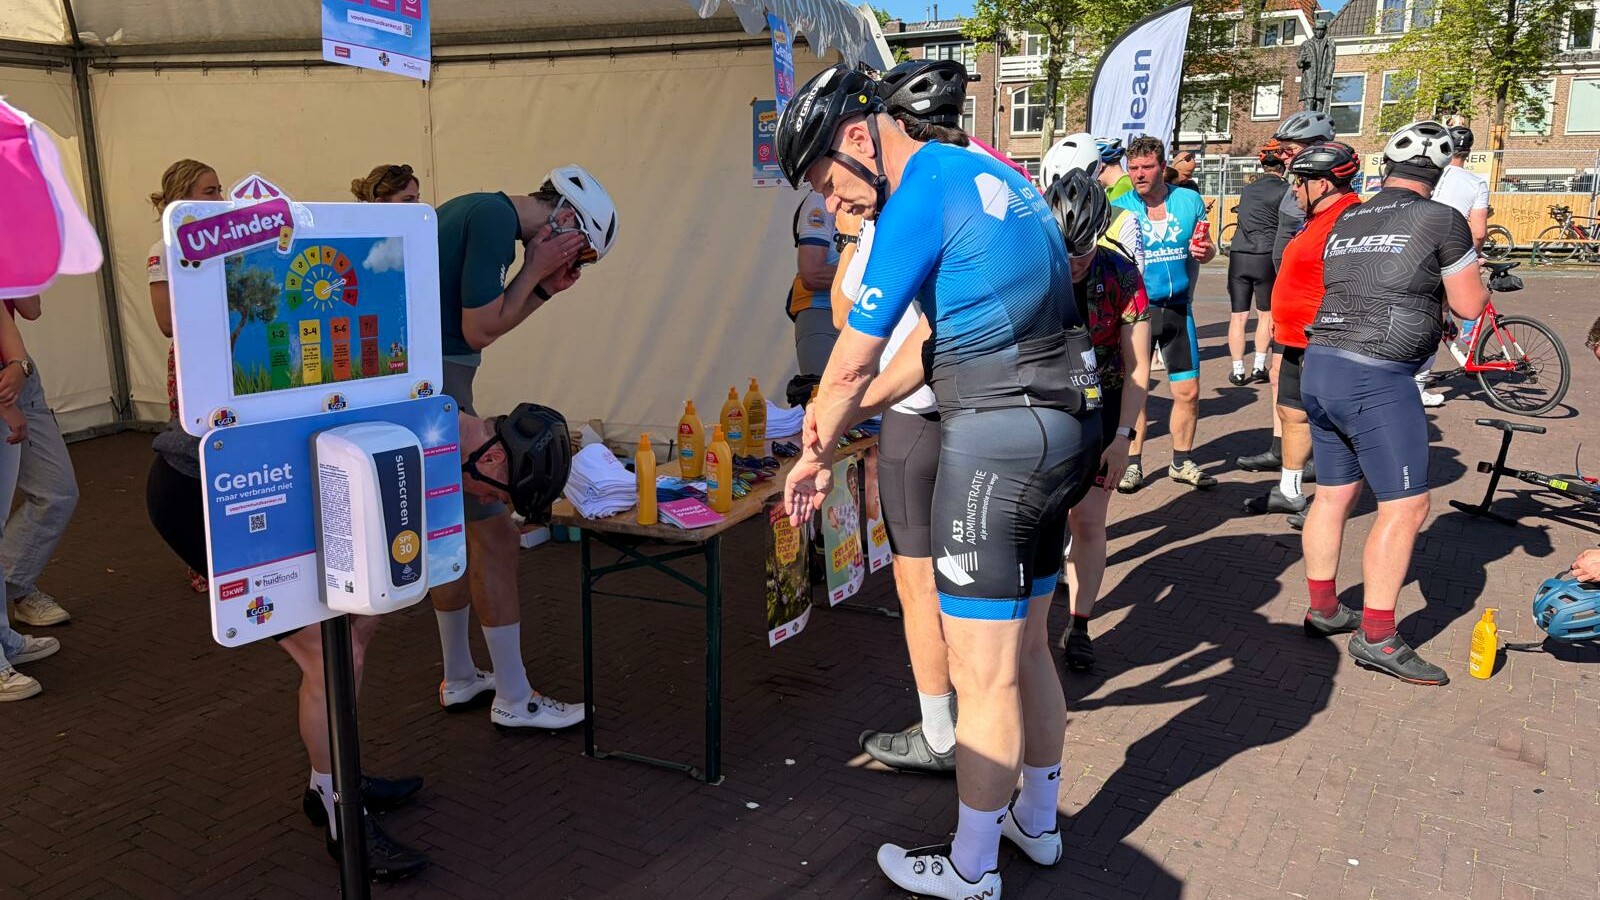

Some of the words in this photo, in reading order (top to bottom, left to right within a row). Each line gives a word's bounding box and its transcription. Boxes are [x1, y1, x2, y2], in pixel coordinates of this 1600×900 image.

[800, 88, 819, 116] GIRO
[187, 211, 285, 251] UV-index
[1331, 234, 1411, 250] CUBE
[1144, 247, 1184, 258] Bakker
[1348, 245, 1390, 254] FRIESLAND
[298, 261, 304, 269] 3
[271, 330, 285, 339] 1-2
[303, 328, 317, 336] 3-4
[333, 325, 347, 333] 5-6
[218, 417, 233, 425] GGD
[214, 463, 293, 492] Geniet
[216, 493, 238, 503] maar
[240, 485, 276, 498] verbrand
[278, 482, 293, 491] niet
[395, 455, 409, 526] sunscreen
[966, 469, 987, 546] ADMINISTRATIE
[952, 519, 964, 544] A32
[398, 534, 412, 543] SPF
[400, 544, 412, 555] 30
[263, 571, 298, 586] huidfonds
[229, 586, 244, 595] KWF
[251, 605, 269, 616] GGD
